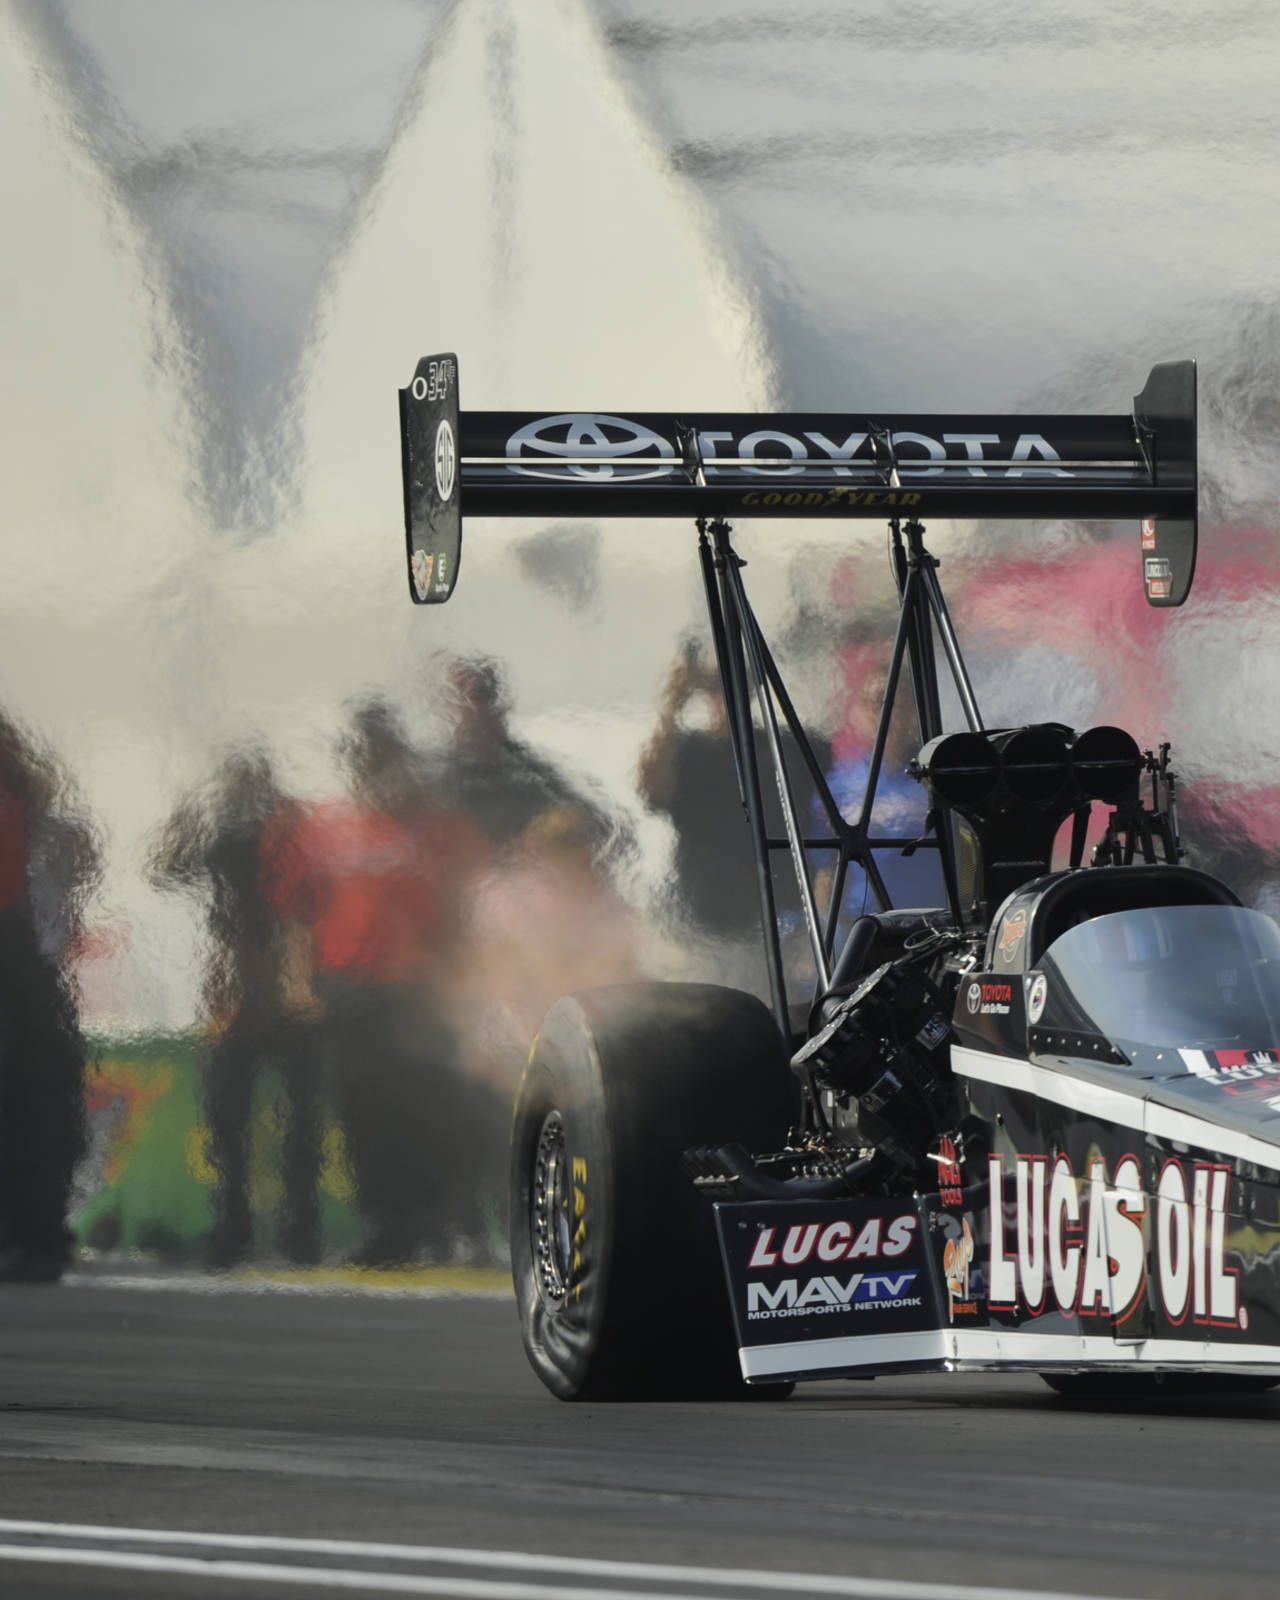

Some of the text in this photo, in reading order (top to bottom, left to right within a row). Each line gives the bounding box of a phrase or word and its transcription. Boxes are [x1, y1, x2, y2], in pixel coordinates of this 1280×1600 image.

[699, 430, 1076, 477] TOYOTA
[981, 983, 1012, 1001] TOYOTA
[747, 1214, 919, 1268] LUCAS
[988, 1153, 1146, 1326] LUCAS
[747, 1272, 917, 1312] MAVTV
[748, 1297, 922, 1321] MOTORSPORTS NETWORK
